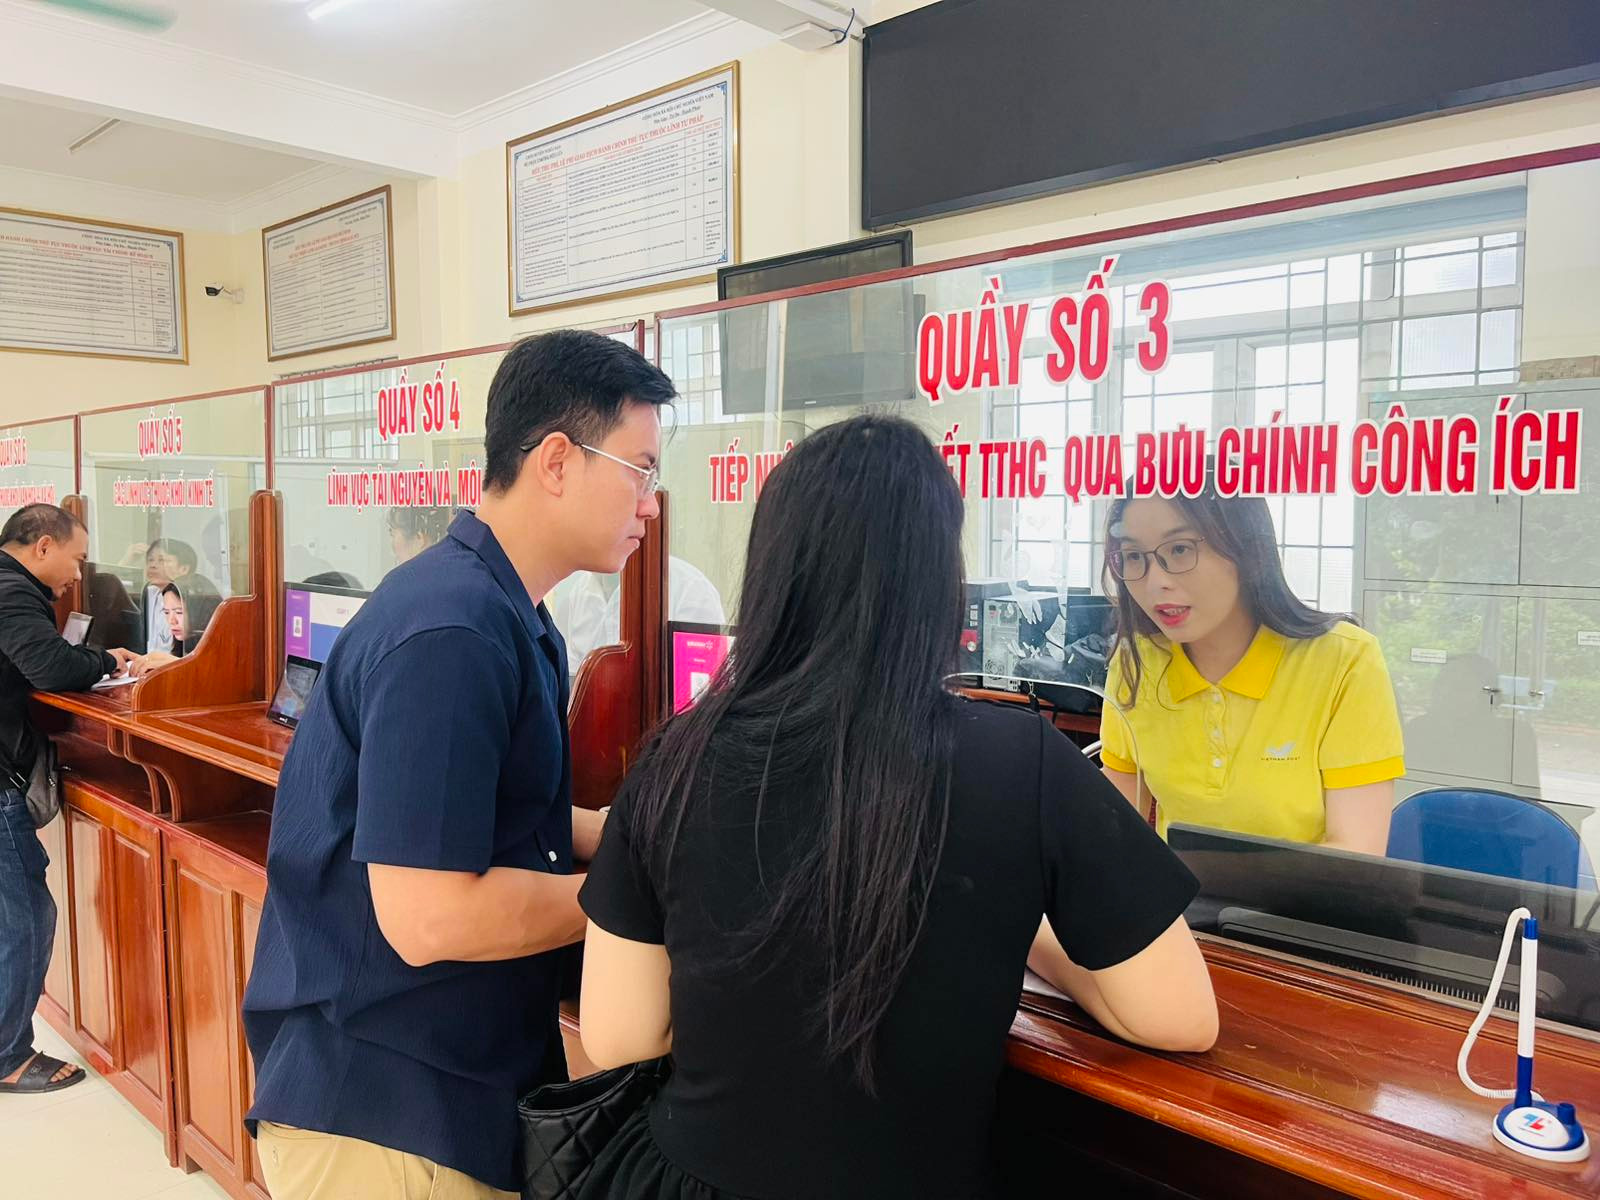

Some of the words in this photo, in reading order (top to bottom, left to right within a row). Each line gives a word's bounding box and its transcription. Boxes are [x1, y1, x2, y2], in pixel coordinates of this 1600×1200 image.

[917, 274, 1030, 403] QUẦY
[1046, 257, 1115, 383] SỐ
[1137, 280, 1171, 373] 3
[138, 406, 160, 460] QUẦY
[162, 403, 174, 454] SỐ
[176, 417, 183, 453] 5
[377, 367, 419, 442] QUẦY
[423, 361, 446, 433] SỐ
[449, 380, 461, 430] 4
[371, 464, 388, 506] TÀI
[389, 463, 434, 506] NGUYÊN
[435, 460, 452, 506] VÀ
[457, 460, 482, 506] MÔI
[709, 437, 749, 502] TIẾP
[979, 439, 1047, 500] TTHC
[1064, 434, 1124, 504] QUA
[1134, 424, 1206, 495] BƯU
[1216, 411, 1339, 495] CHÍNH
[1352, 404, 1477, 496] CÔNG
[1493, 396, 1580, 495] ÍCH
